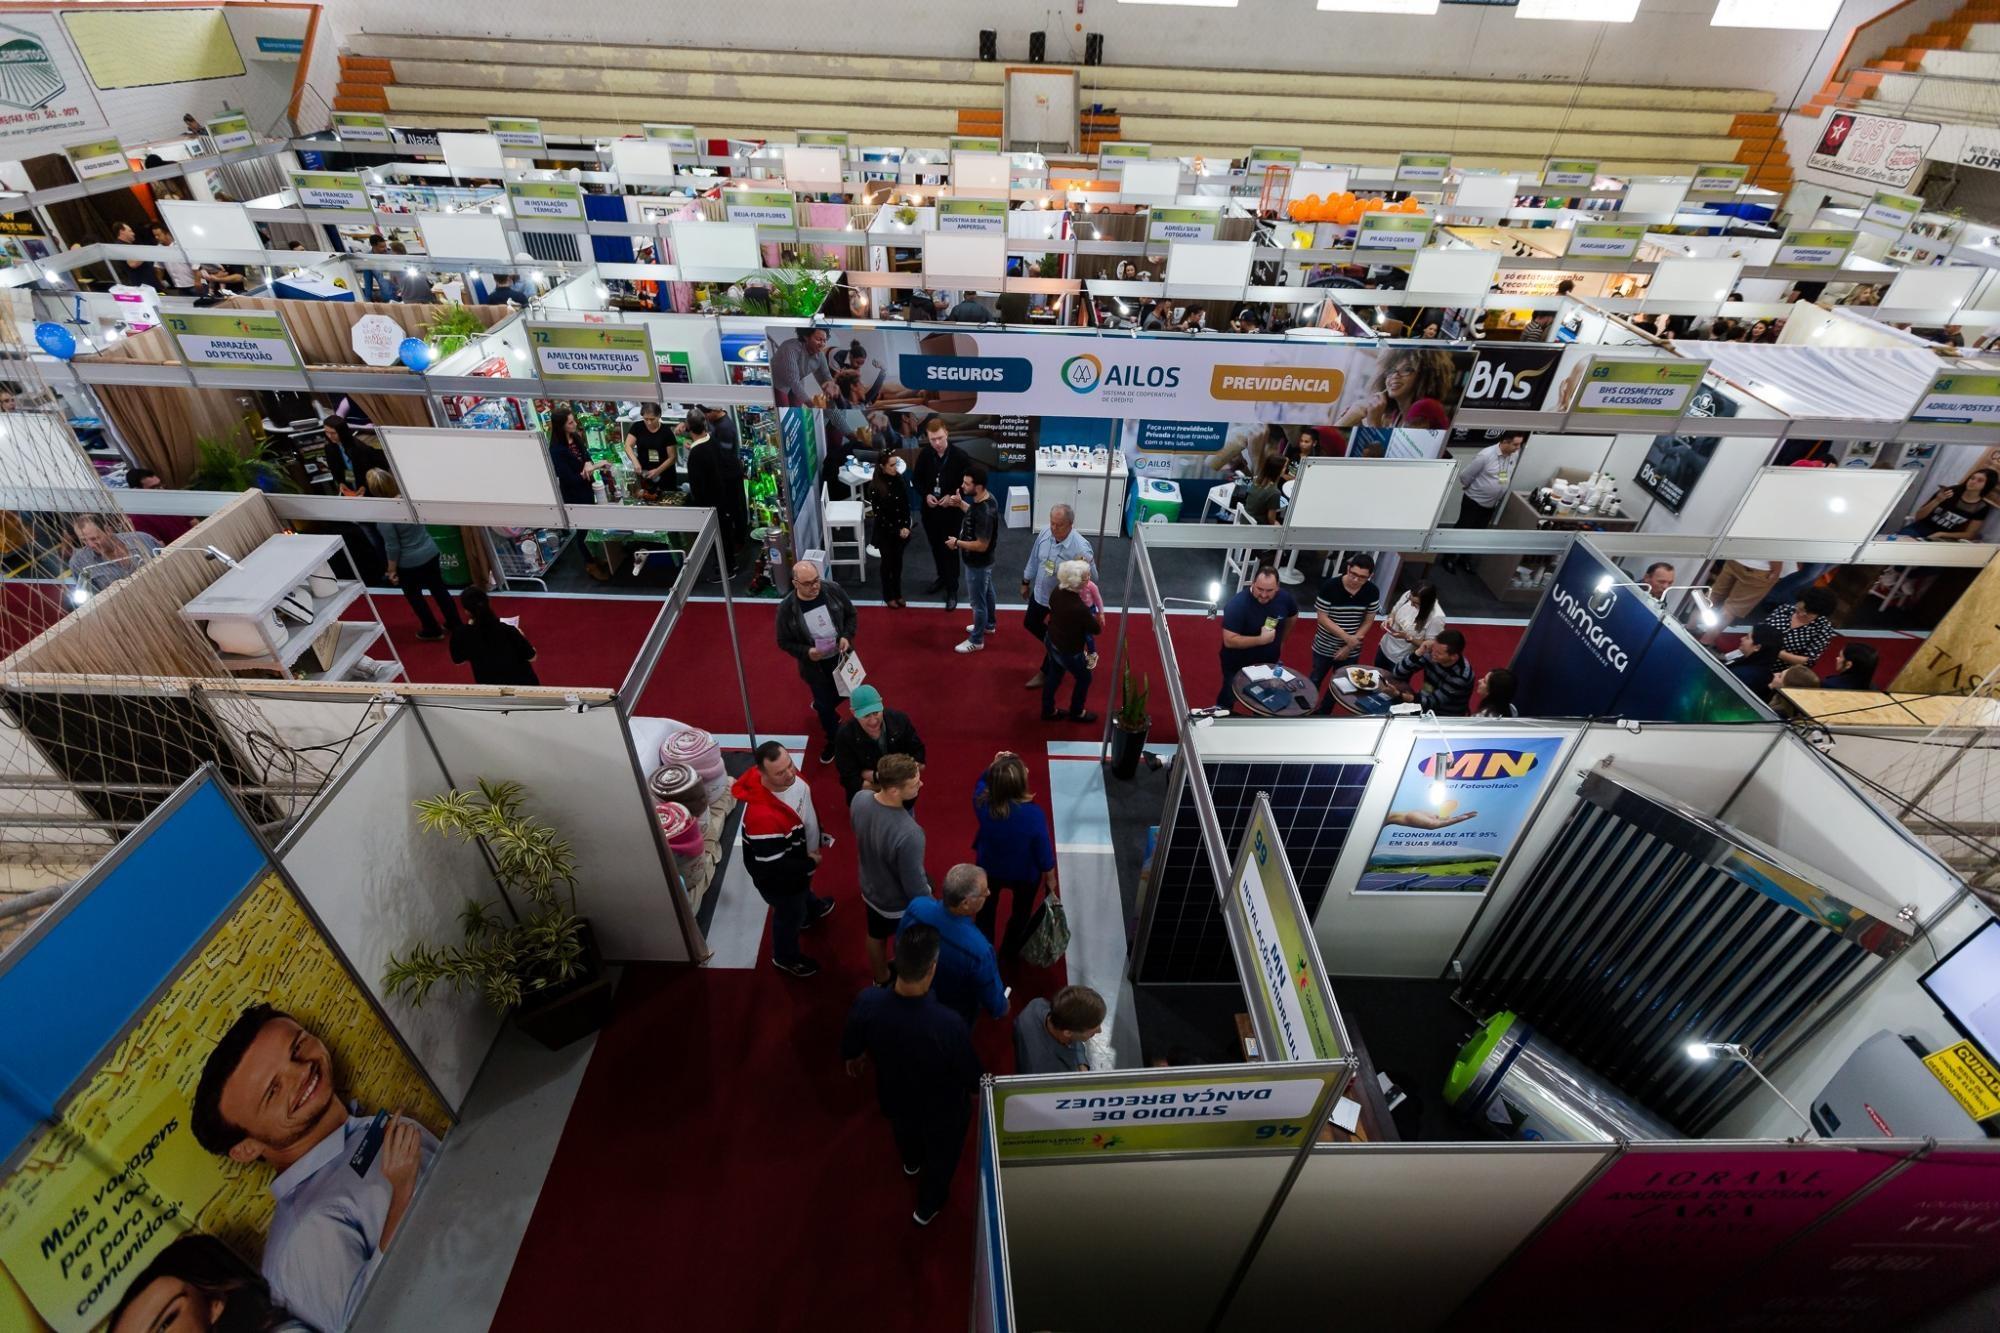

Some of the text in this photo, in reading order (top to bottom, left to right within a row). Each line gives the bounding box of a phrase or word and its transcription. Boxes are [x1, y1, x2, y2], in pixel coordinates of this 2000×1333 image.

[531, 199, 568, 208] INSTALAÇÕES
[533, 206, 562, 214] TÉRMICAS
[943, 216, 970, 224] INDÚSTRIA
[1165, 231, 1198, 239] FOTOGRAFIA
[168, 319, 187, 331] 73
[533, 332, 550, 343] 72
[210, 340, 258, 351] ARMAZÉM
[205, 350, 273, 362] DO PETISQUÃO
[547, 352, 640, 362] AMILTON MATERIAIS
[558, 362, 633, 373] DE CONSTRUÇÃO
[1592, 367, 1609, 378] 69
[926, 365, 1004, 382] SEGUROS
[1104, 364, 1181, 388] AILOS
[1222, 374, 1330, 393] PREVIDÊNCIA
[1466, 360, 1536, 400] Bhs
[1935, 379, 1953, 390] 68
[1599, 386, 1674, 397] BHS COSMÉTICOS
[1608, 395, 1663, 406] ACESSÓRIOS
[1146, 424, 1163, 432] Faça
[1191, 433, 1220, 441] tranquilo
[1147, 460, 1171, 468] AILOS
[1552, 583, 1629, 673] unimarca
[1424, 752, 1537, 778] MN
[1459, 782, 1519, 790] Fotovoltaico
[1460, 829, 1476, 838] ATÉ
[1434, 838, 1458, 847] MÃOS
[1242, 879, 1274, 983] INSTALAÇÕES
[1270, 942, 1287, 988] MN
[1055, 1087, 1272, 1110] DANÇA BREGUEZ
[1092, 1104, 1228, 1122] STUDIO DE
[1255, 1124, 1303, 1140] 46
[41, 1205, 89, 1260] Mais
[60, 1217, 108, 1280] para
[81, 1263, 93, 1280] e
[100, 1208, 144, 1268] para
